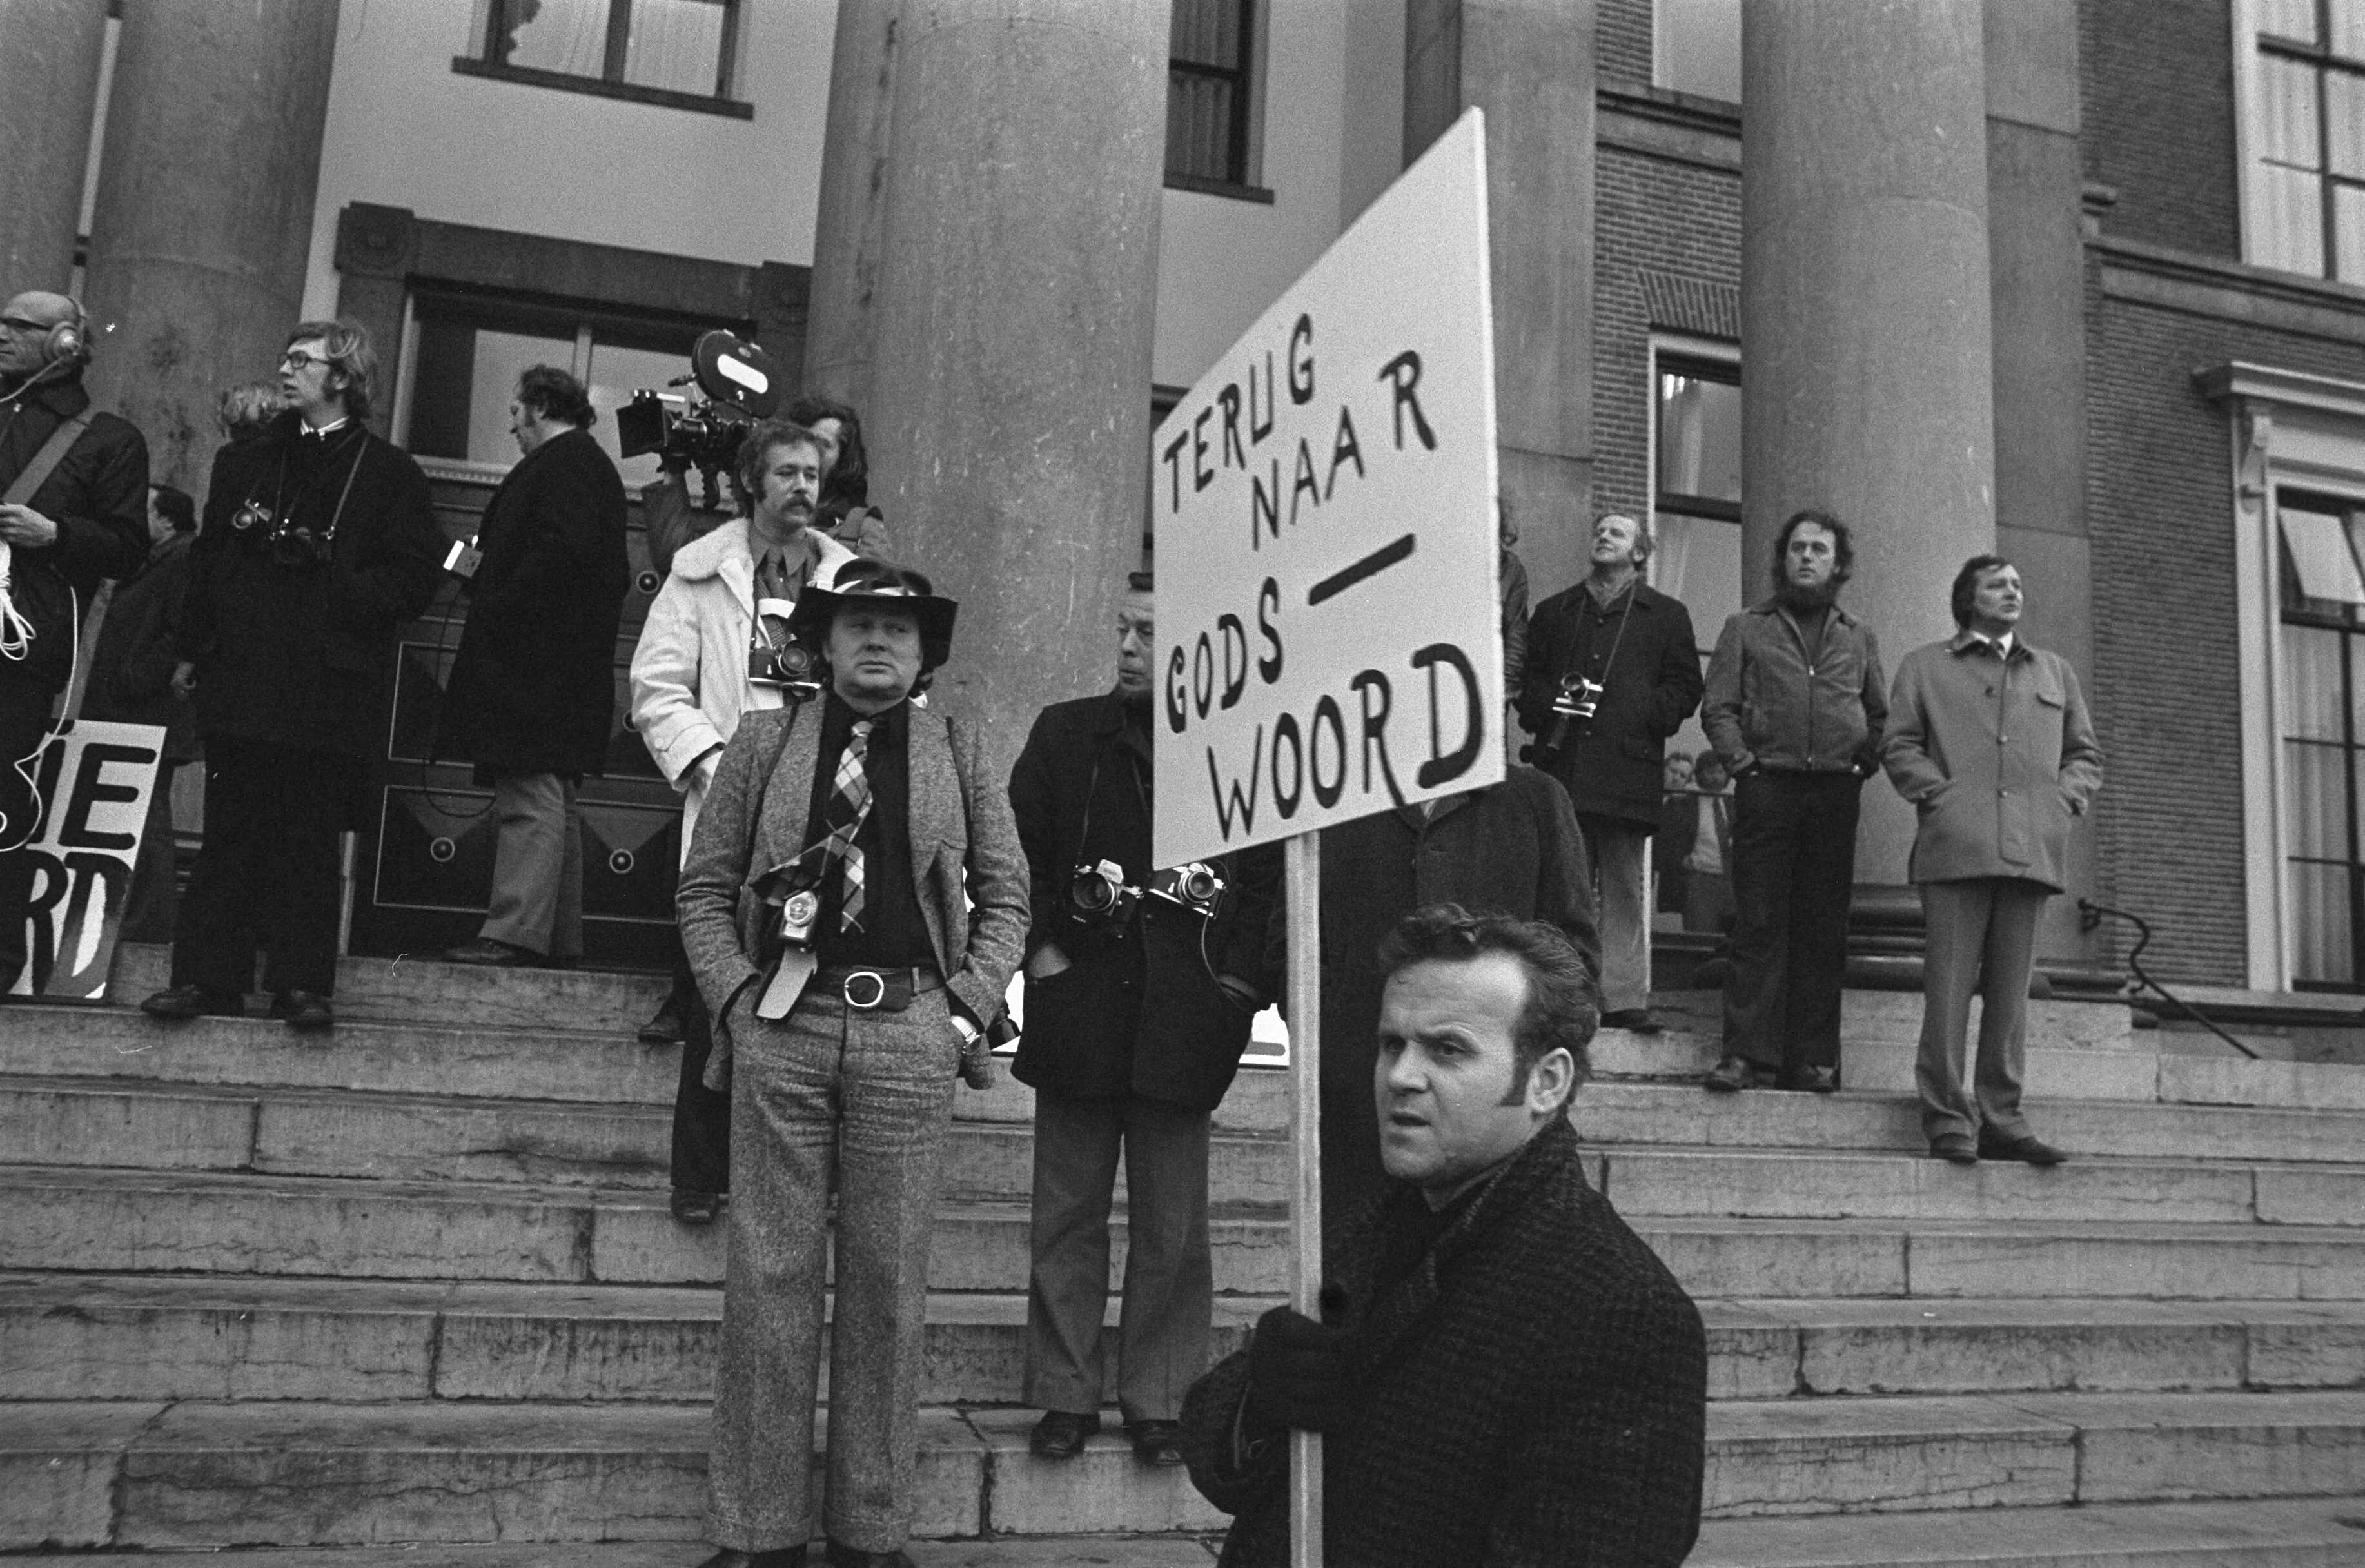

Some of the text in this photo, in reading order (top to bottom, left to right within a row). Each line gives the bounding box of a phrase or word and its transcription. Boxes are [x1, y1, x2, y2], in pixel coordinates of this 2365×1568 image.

[1163, 313, 1313, 514] TERUG
[1253, 349, 1437, 552] NAAR
[1166, 576, 1283, 734] GODS
[1207, 643, 1484, 843] WOORD
